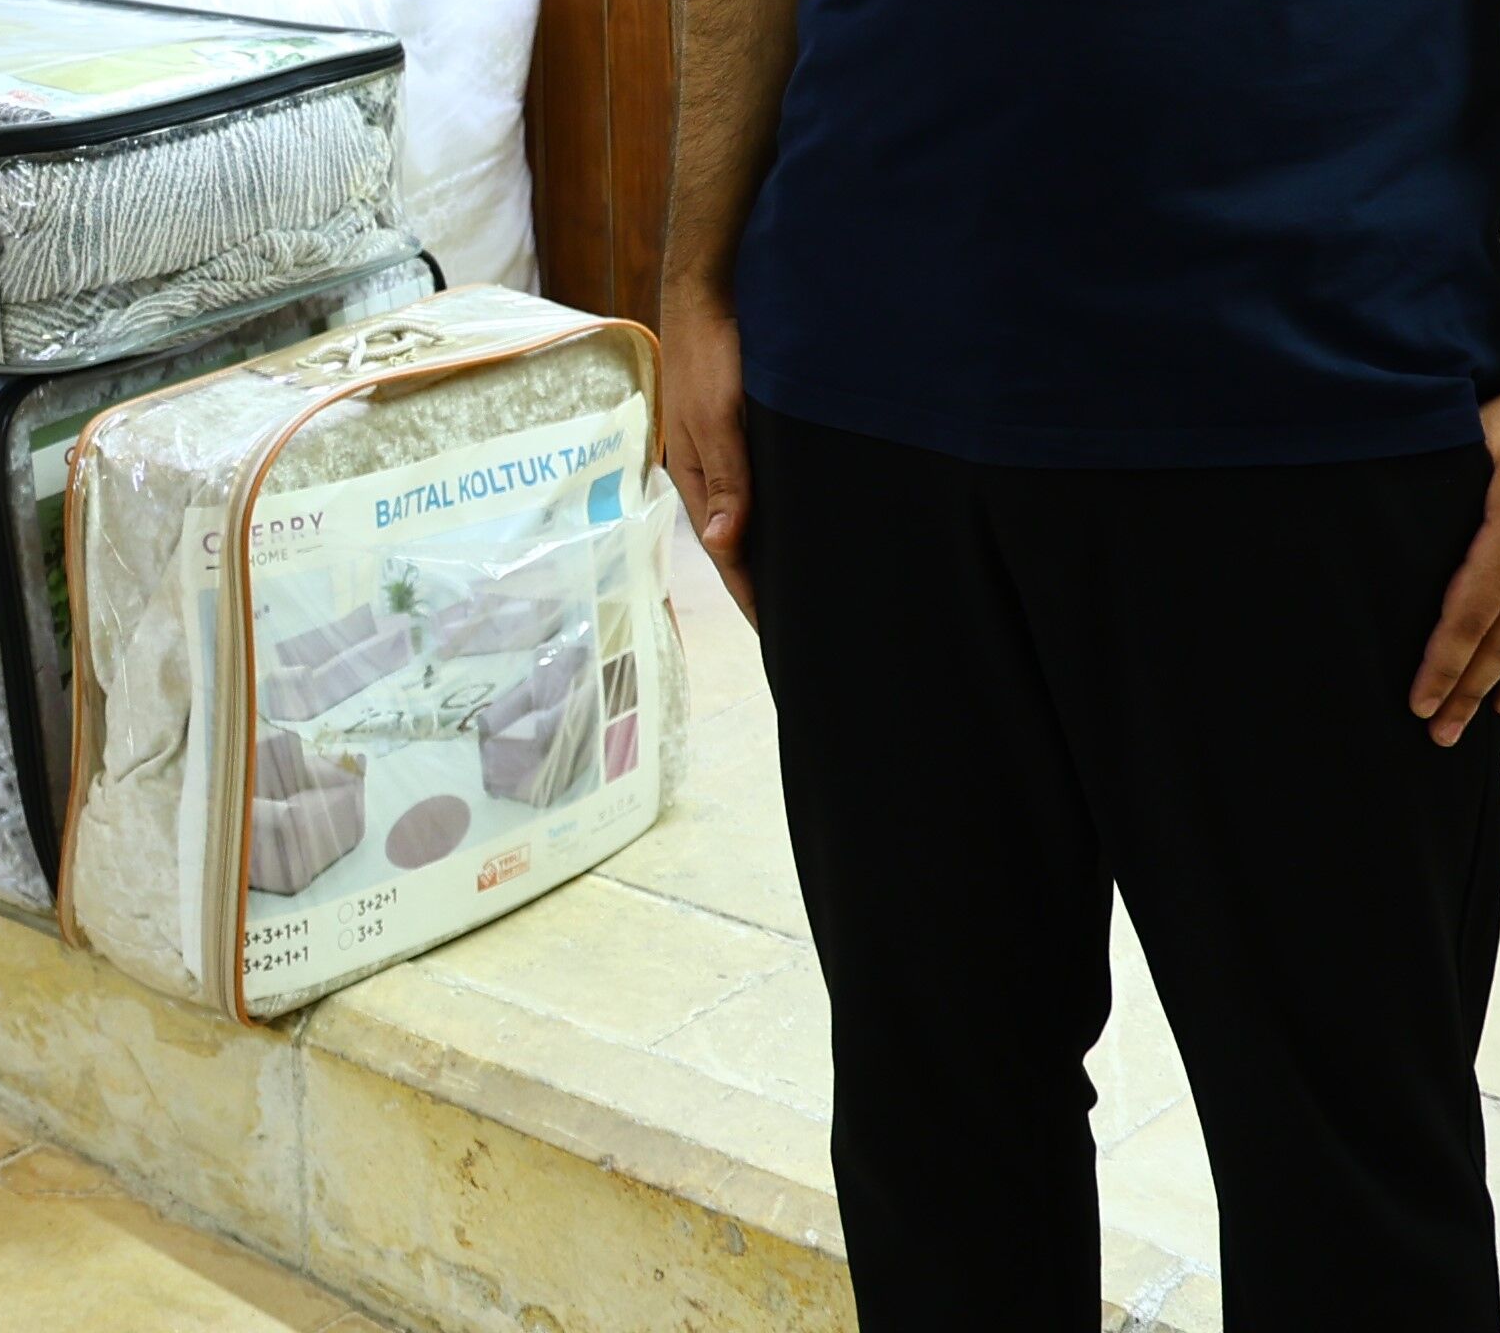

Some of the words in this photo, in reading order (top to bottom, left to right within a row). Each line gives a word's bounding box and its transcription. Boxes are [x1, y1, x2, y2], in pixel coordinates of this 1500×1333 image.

[376, 480, 454, 529] BATTAL
[458, 453, 558, 502] KOLTUK
[203, 511, 323, 555] CERRY
[357, 888, 398, 916] 3+2+1
[357, 919, 384, 943] 3+3
